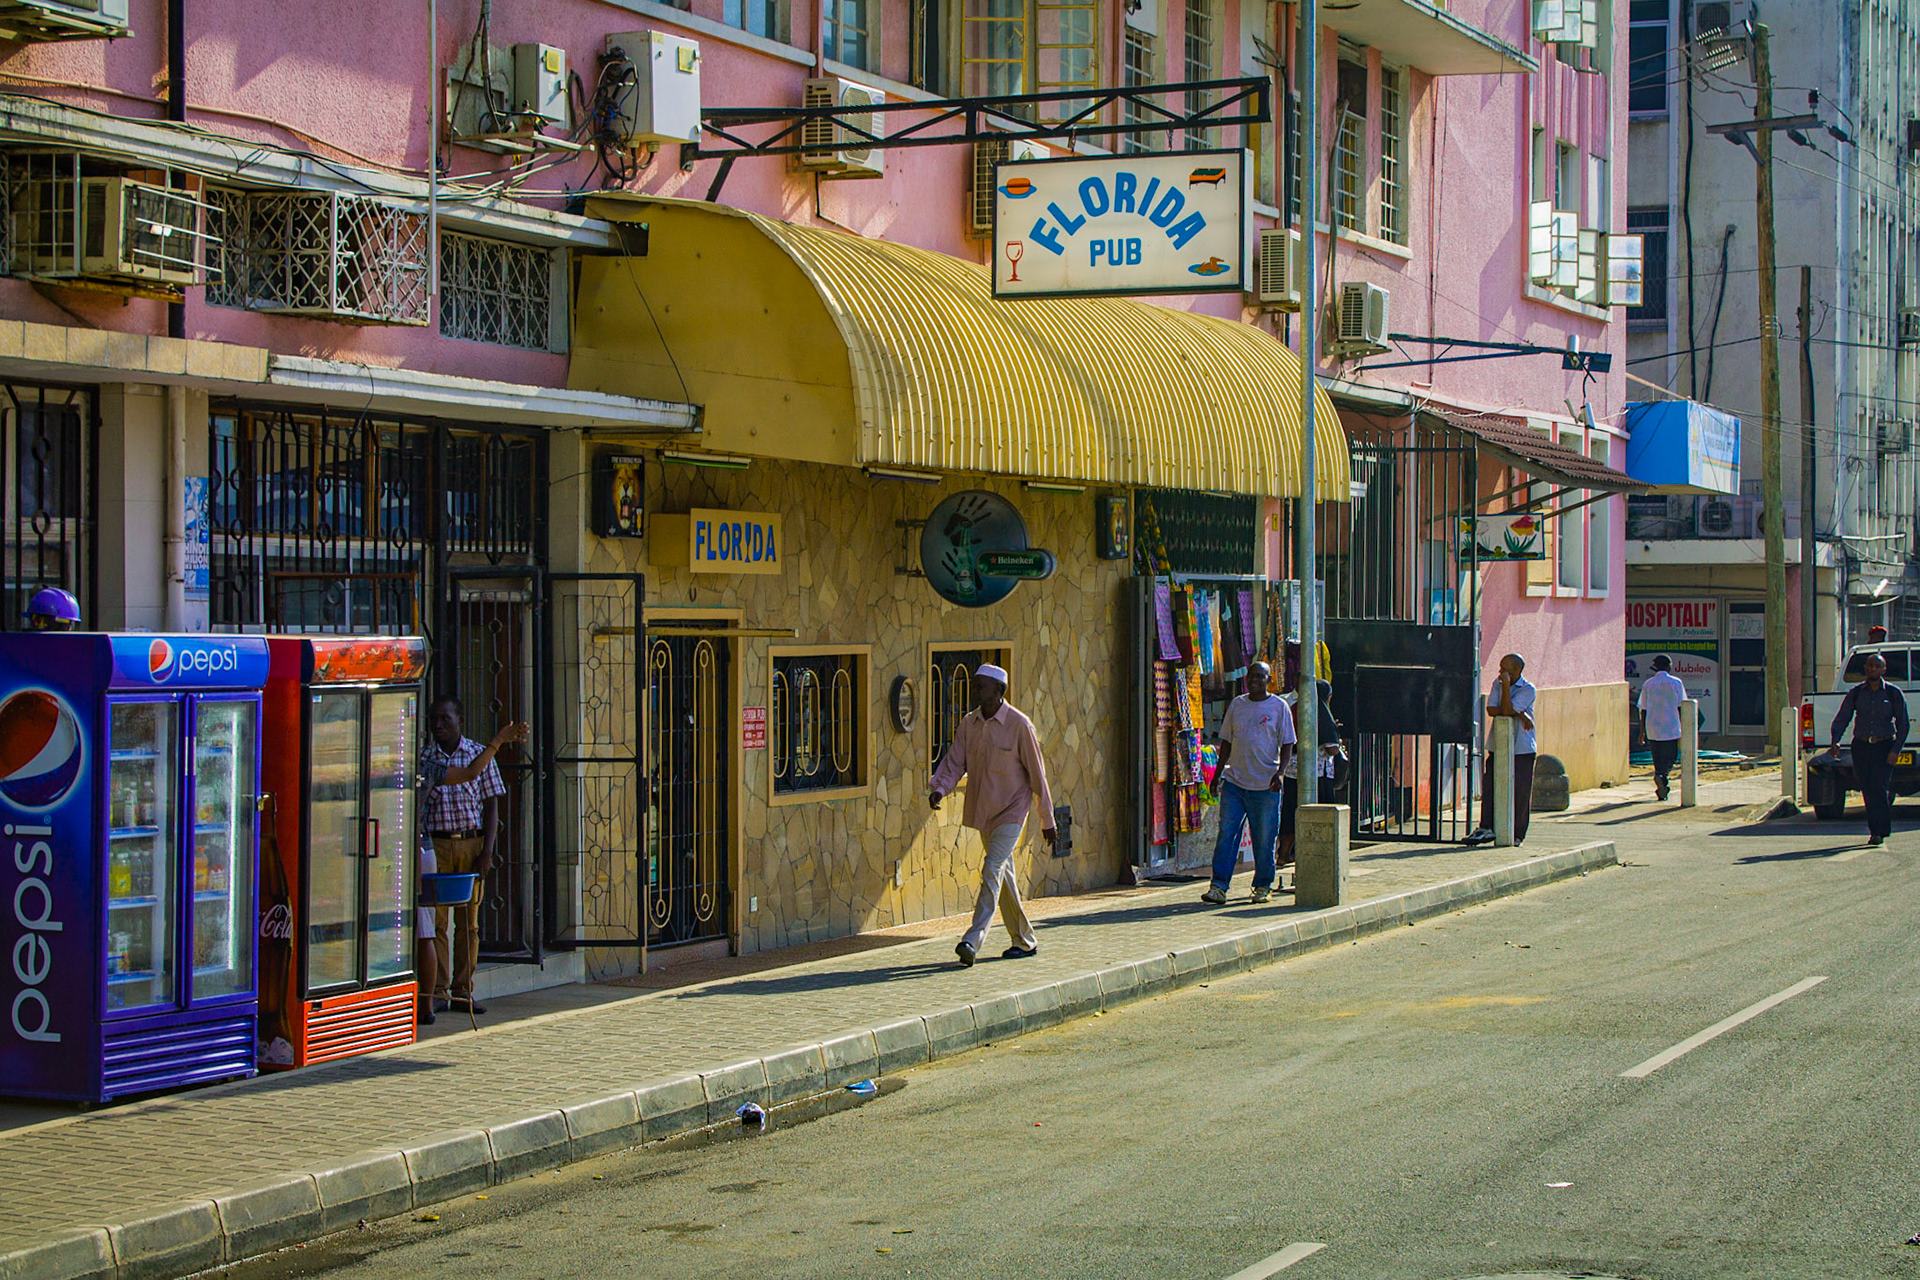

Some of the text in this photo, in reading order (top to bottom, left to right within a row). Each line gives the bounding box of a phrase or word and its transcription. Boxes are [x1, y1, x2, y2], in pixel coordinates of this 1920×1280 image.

[1029, 172, 1207, 256] FLORIDA
[1090, 238, 1142, 267] PUB
[696, 520, 776, 563] FLORIDA
[998, 556, 1034, 564] Heineken
[1682, 628, 1716, 636] Polyclinic
[178, 644, 238, 677] pepsi
[1675, 660, 1711, 673] Jubilee
[4, 825, 62, 1043] pepsi
